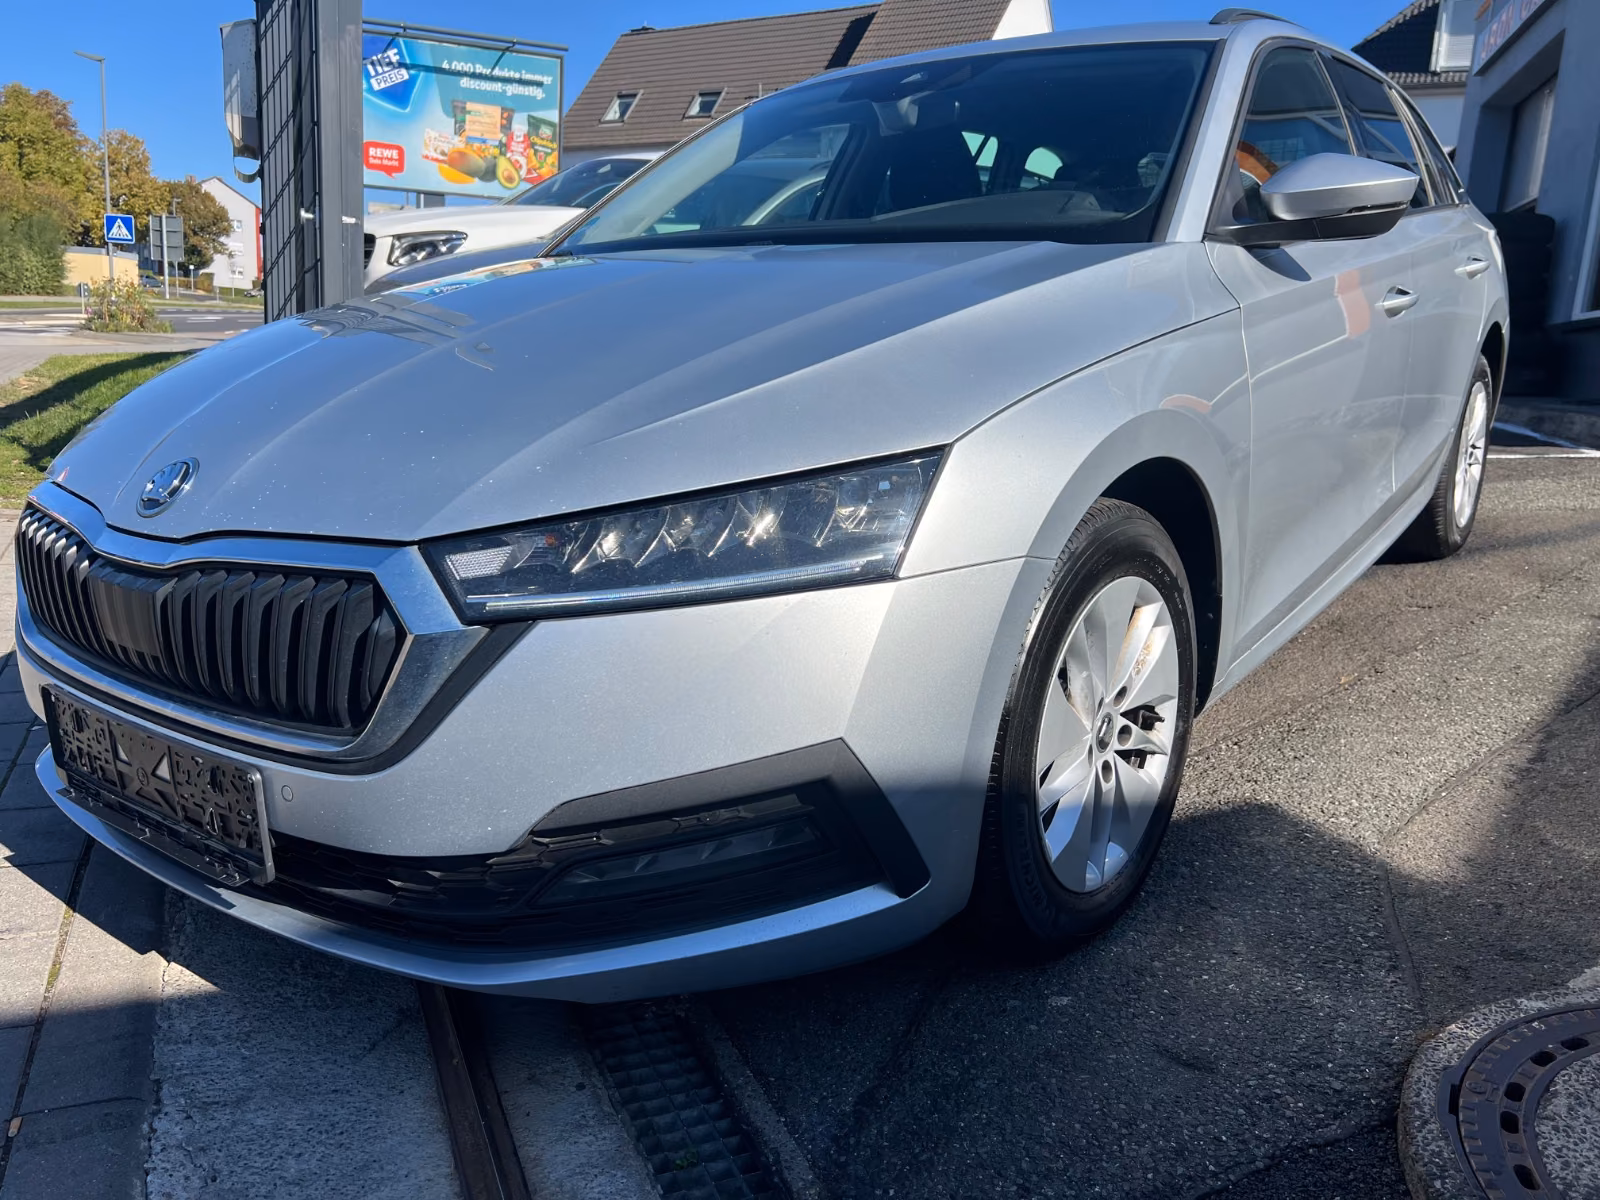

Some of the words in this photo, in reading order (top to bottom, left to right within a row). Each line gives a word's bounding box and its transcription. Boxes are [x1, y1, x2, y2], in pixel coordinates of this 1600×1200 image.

[364, 48, 400, 77] TIEF
[374, 69, 405, 88] PREIS
[521, 69, 553, 85] immer
[368, 147, 399, 159] REWE
